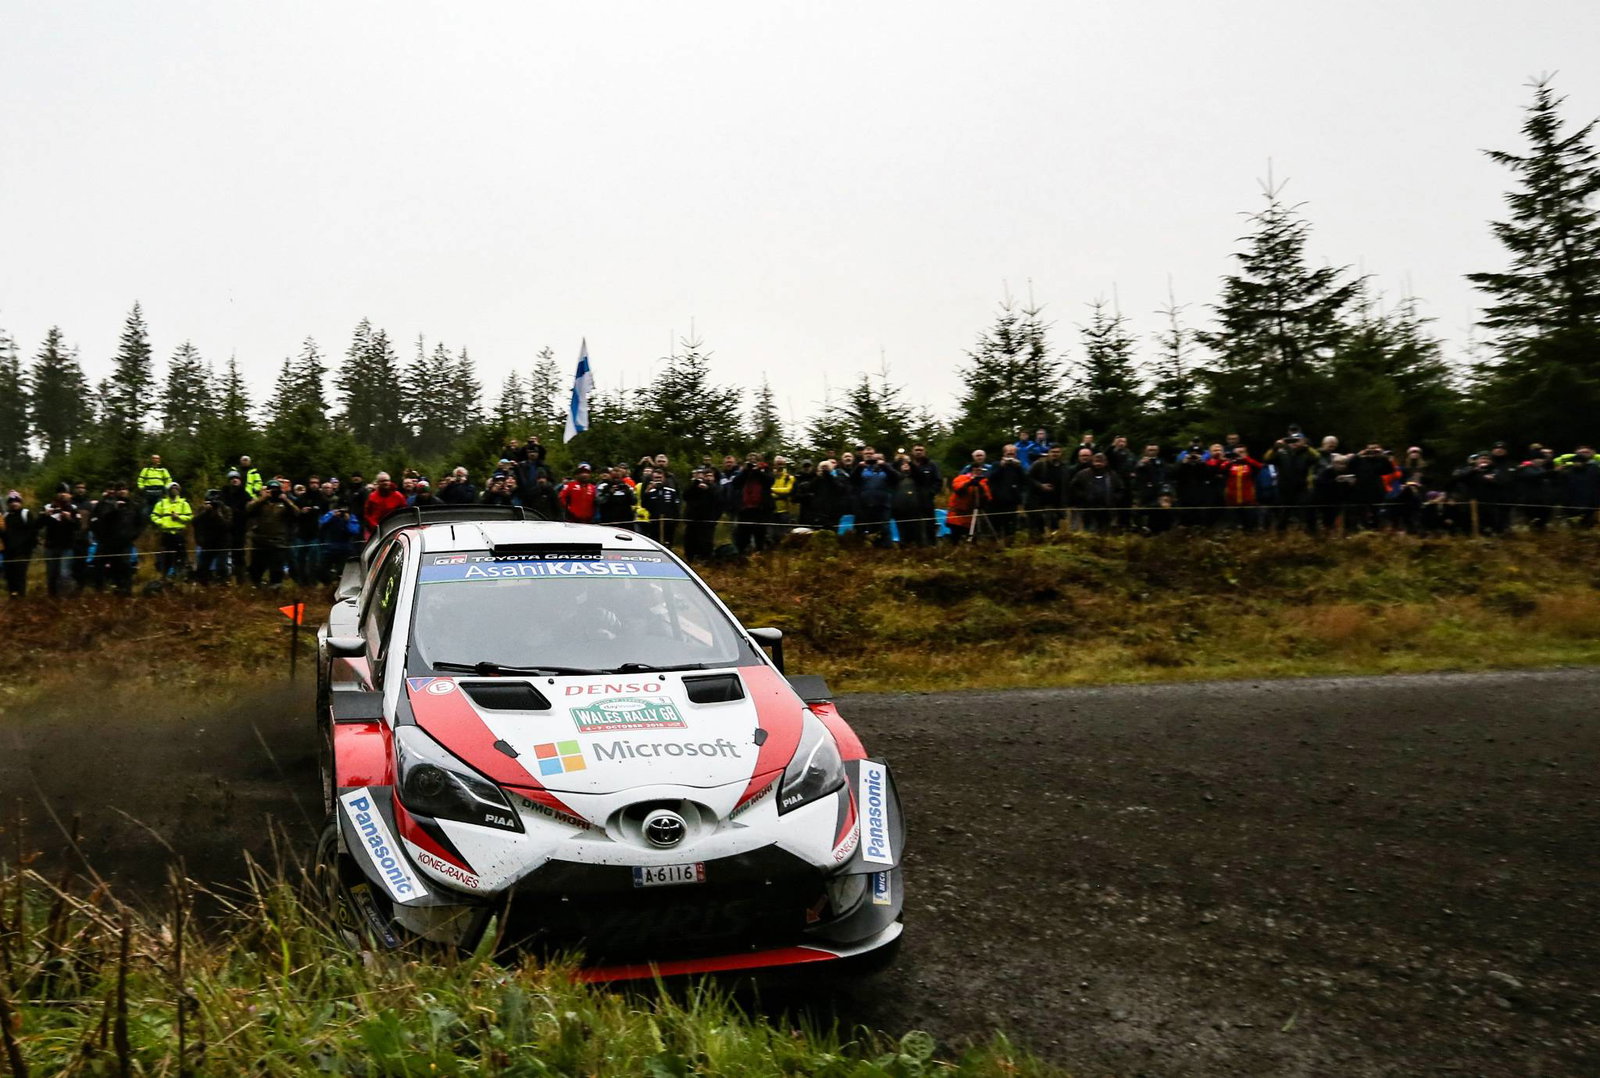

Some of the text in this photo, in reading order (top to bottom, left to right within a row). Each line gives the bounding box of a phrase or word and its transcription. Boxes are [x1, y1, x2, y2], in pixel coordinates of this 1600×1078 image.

[434, 555, 468, 565] GR
[472, 554, 541, 562] TOYOTA
[565, 682, 662, 697] DENSO
[575, 706, 678, 725] WALES RALLY GB
[592, 738, 742, 762] Microsoft
[782, 793, 804, 808] PIAA
[485, 813, 515, 828] PIAA
[521, 799, 591, 830] DMG MORI
[866, 769, 887, 859] Panasonic
[349, 796, 412, 894] Panasonic
[417, 851, 480, 889] KONECRANES
[645, 865, 693, 883] A-6116
